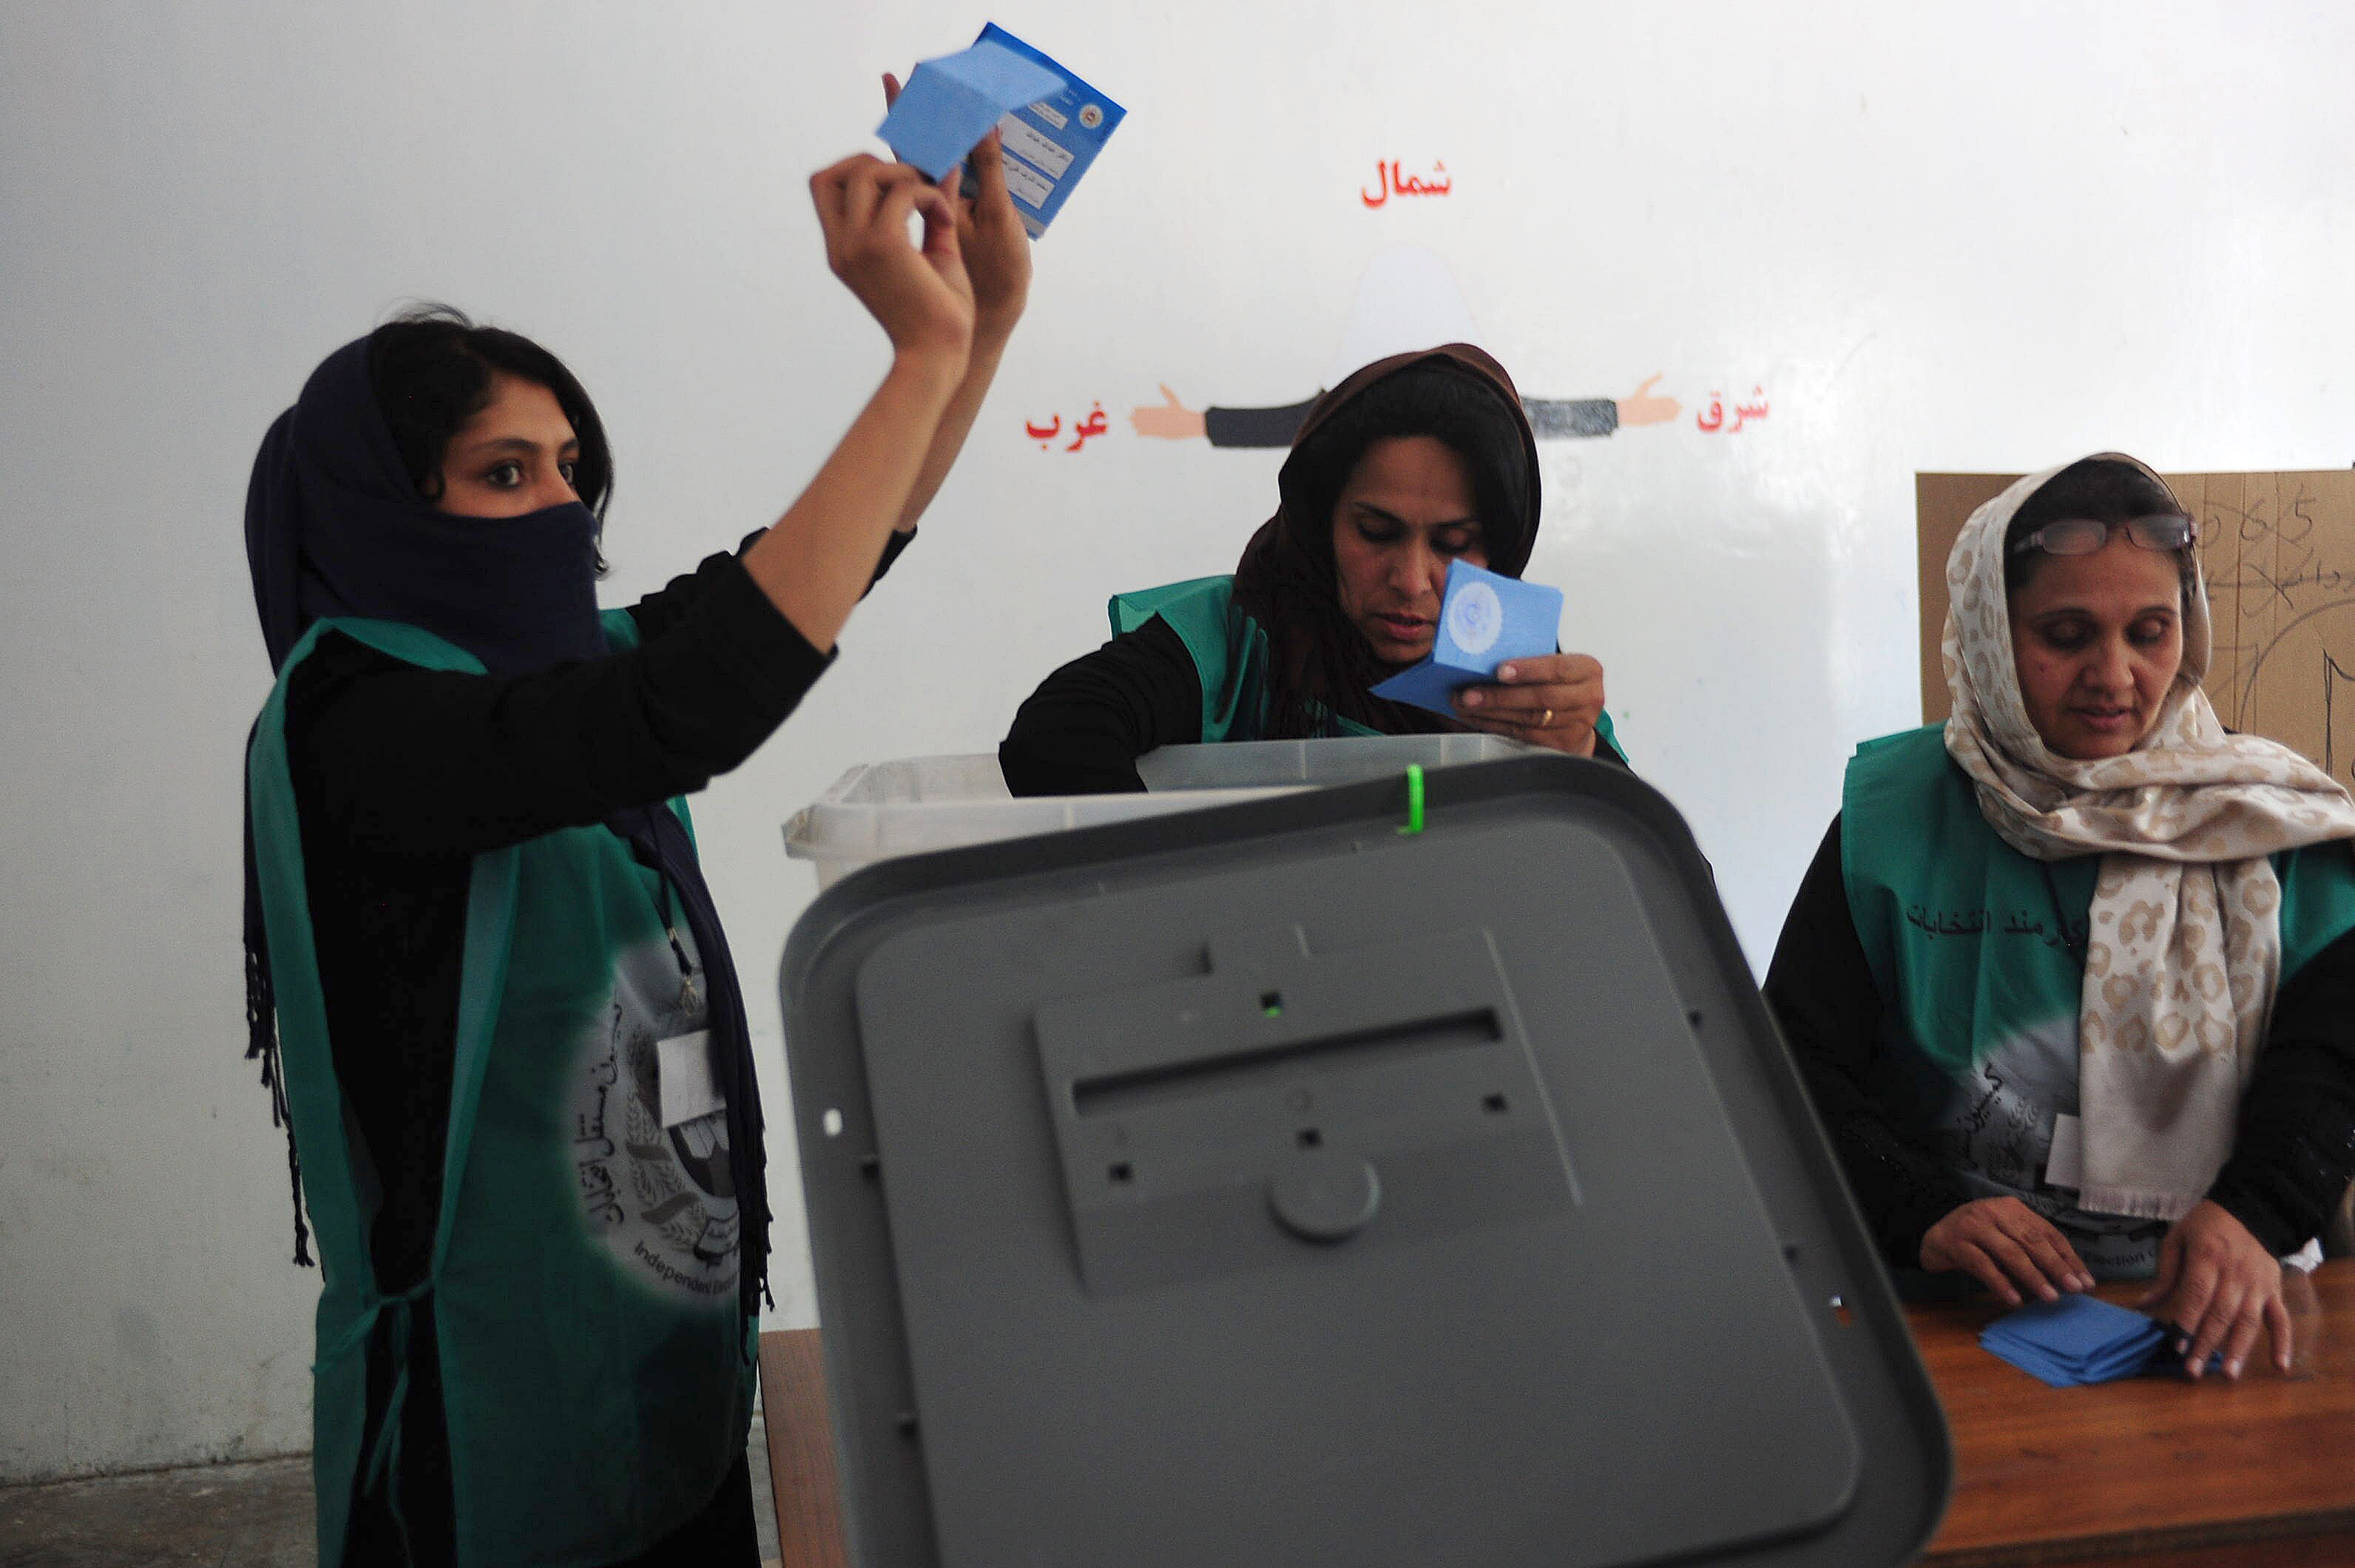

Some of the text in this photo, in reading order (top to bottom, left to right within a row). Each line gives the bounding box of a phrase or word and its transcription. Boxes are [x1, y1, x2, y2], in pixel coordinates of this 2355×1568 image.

[1361, 158, 1452, 209] شمال
[1025, 402, 1108, 453] غرب
[1697, 385, 1768, 433] شرق
